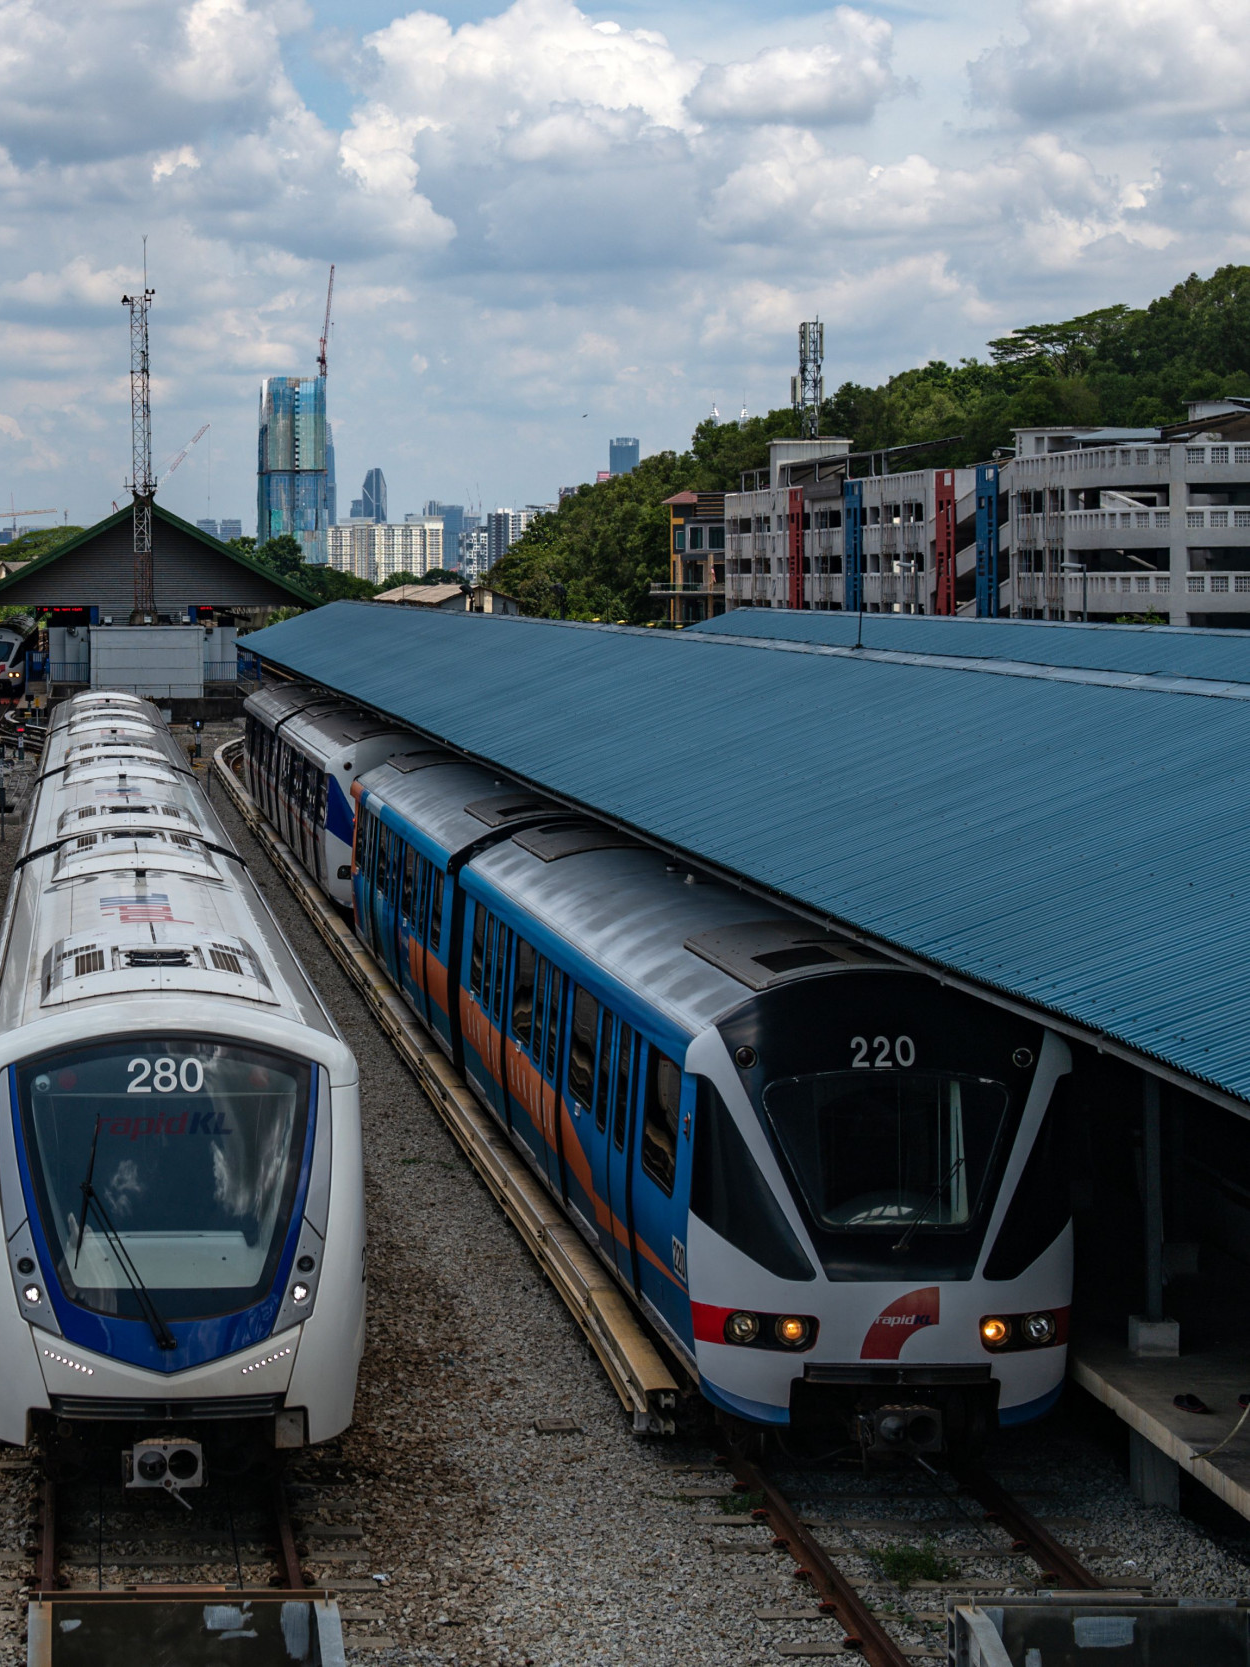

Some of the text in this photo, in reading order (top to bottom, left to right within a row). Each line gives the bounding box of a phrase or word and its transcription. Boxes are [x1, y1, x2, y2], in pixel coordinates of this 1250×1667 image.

[850, 1036, 916, 1068] 220
[127, 1057, 205, 1093] 280
[95, 1111, 233, 1143] rapidKL
[874, 1313, 933, 1328] rapidKL
